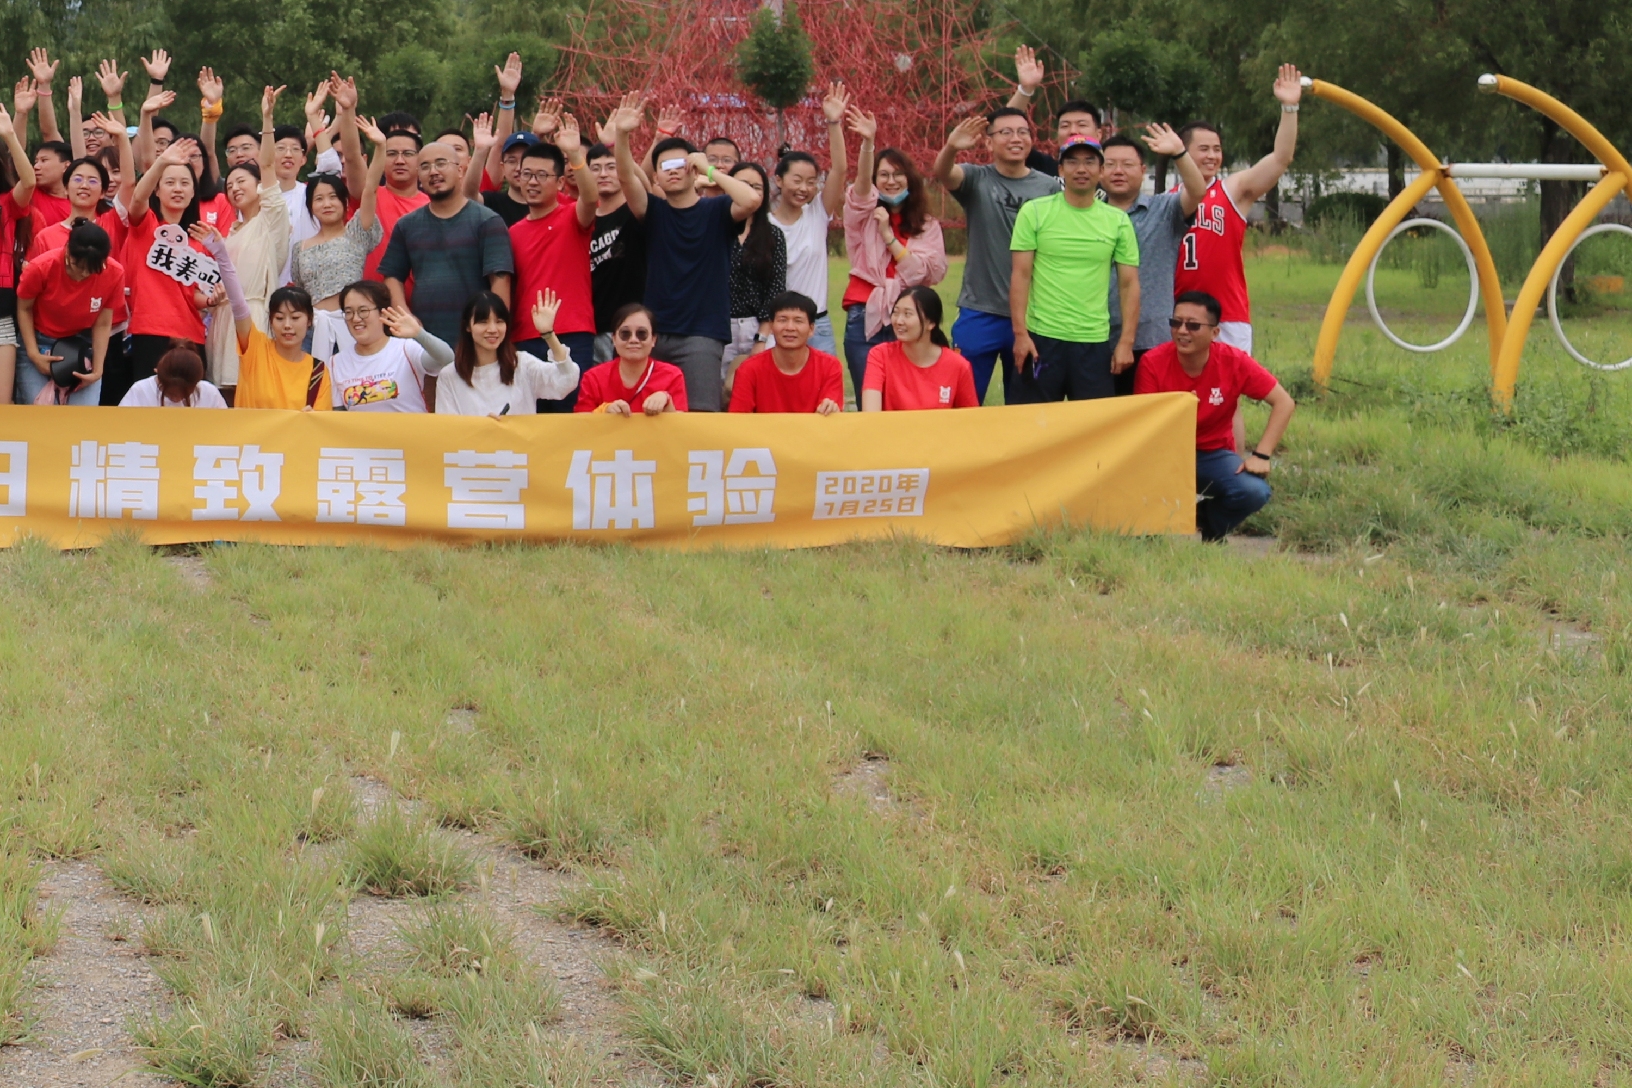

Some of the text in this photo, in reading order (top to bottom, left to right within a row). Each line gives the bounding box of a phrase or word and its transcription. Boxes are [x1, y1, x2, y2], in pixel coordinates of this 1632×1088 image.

[1183, 232, 1198, 270] 1
[824, 473, 920, 495] 2020年
[824, 496, 916, 516] 7月25日
